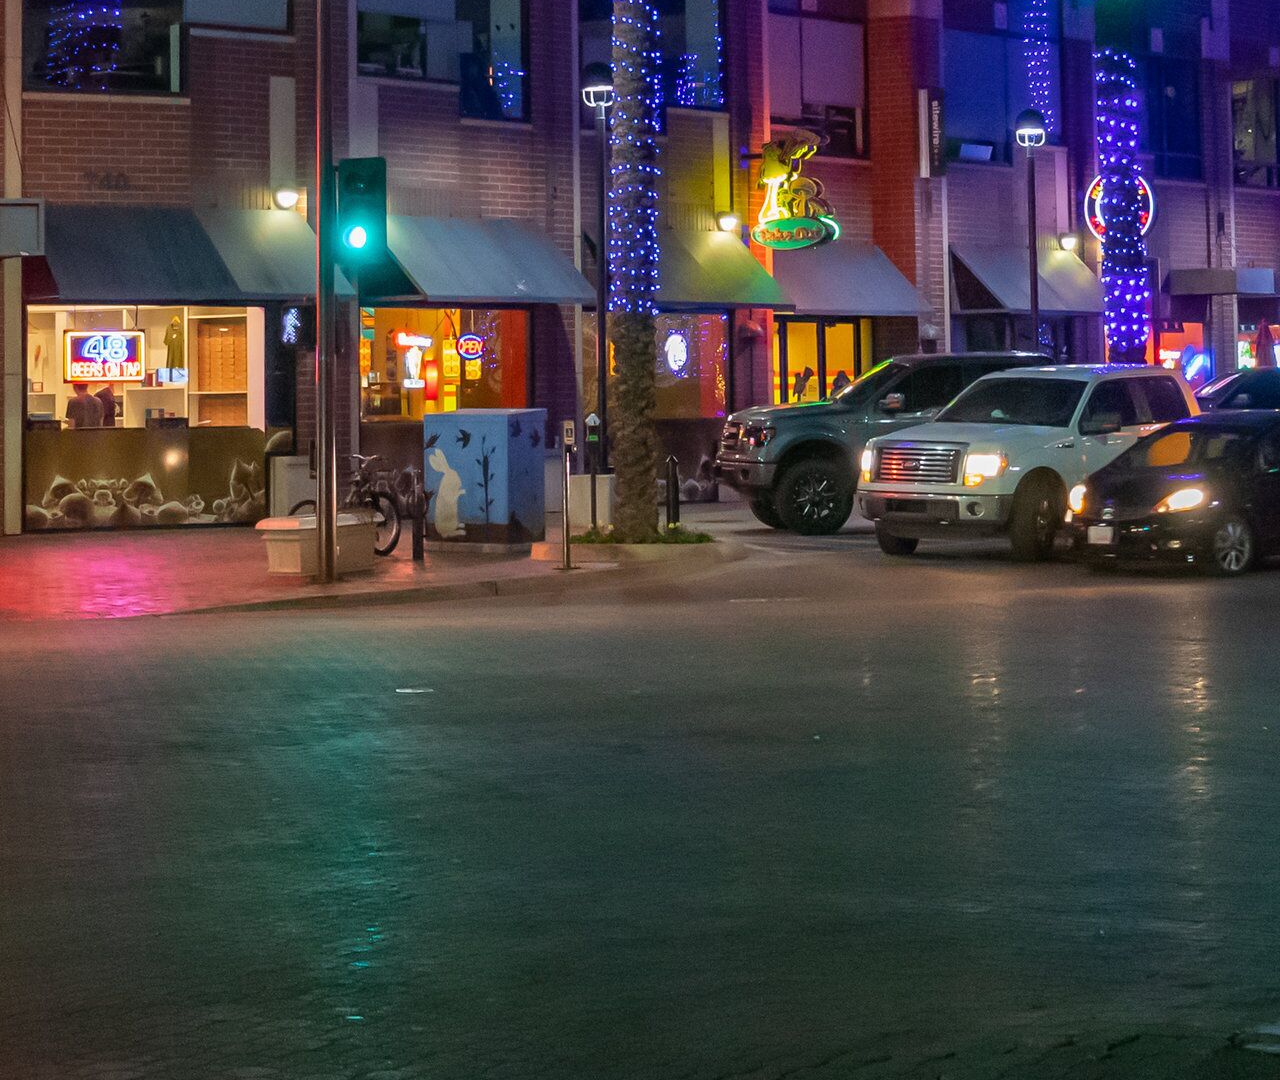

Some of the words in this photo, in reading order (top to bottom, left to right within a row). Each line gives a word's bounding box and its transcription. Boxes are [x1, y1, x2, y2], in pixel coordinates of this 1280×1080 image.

[81, 334, 129, 363] 48
[458, 340, 483, 354] OPEN
[71, 361, 104, 377] BEERS
[105, 361, 120, 377] ON
[121, 361, 141, 377] TAP
